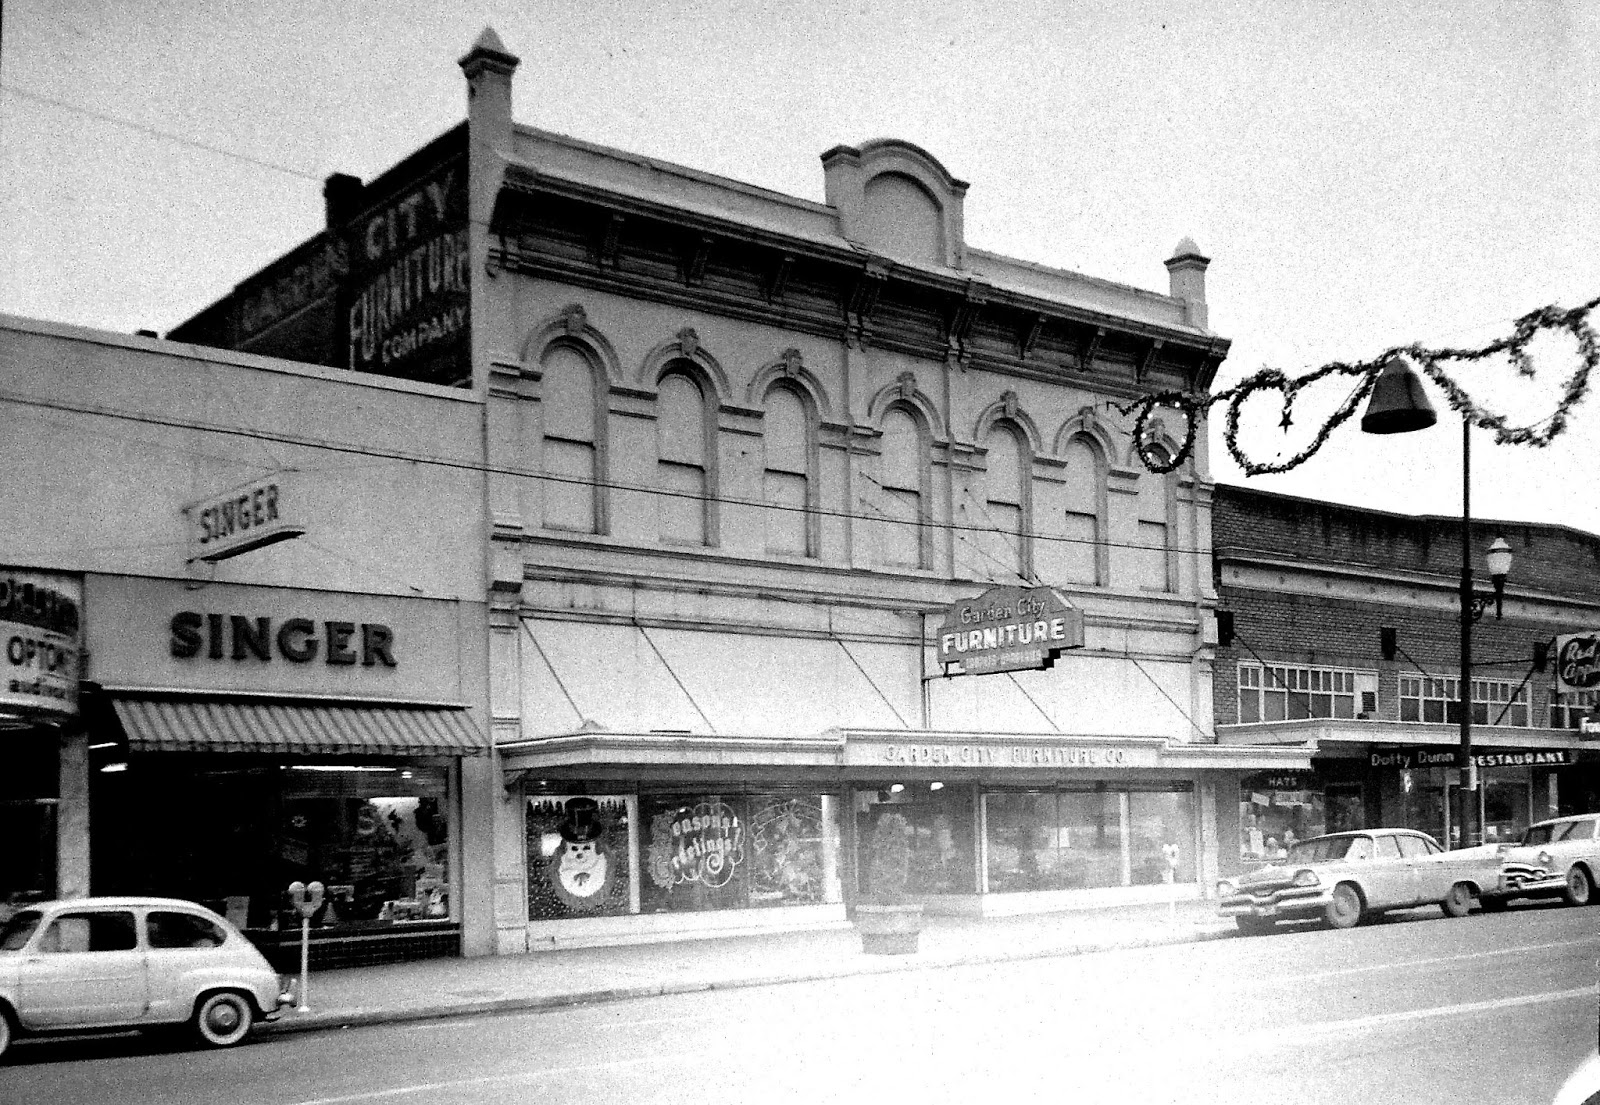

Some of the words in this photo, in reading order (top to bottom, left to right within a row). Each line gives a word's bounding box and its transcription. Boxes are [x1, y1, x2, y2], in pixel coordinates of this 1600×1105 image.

[366, 168, 456, 267] CITY
[349, 233, 470, 371] FURNITURE
[382, 306, 467, 367] COMPANY
[200, 484, 280, 543] SINGER
[960, 602, 1012, 624] Garden
[1017, 595, 1046, 618] City
[170, 610, 398, 668] SINGER
[942, 617, 1066, 655] FURNITURE
[1566, 640, 1598, 661] Red
[885, 746, 953, 764] GARDEN
[960, 746, 995, 764] CITY
[1012, 746, 1097, 765] FURNITURE
[1269, 777, 1298, 787] HATS
